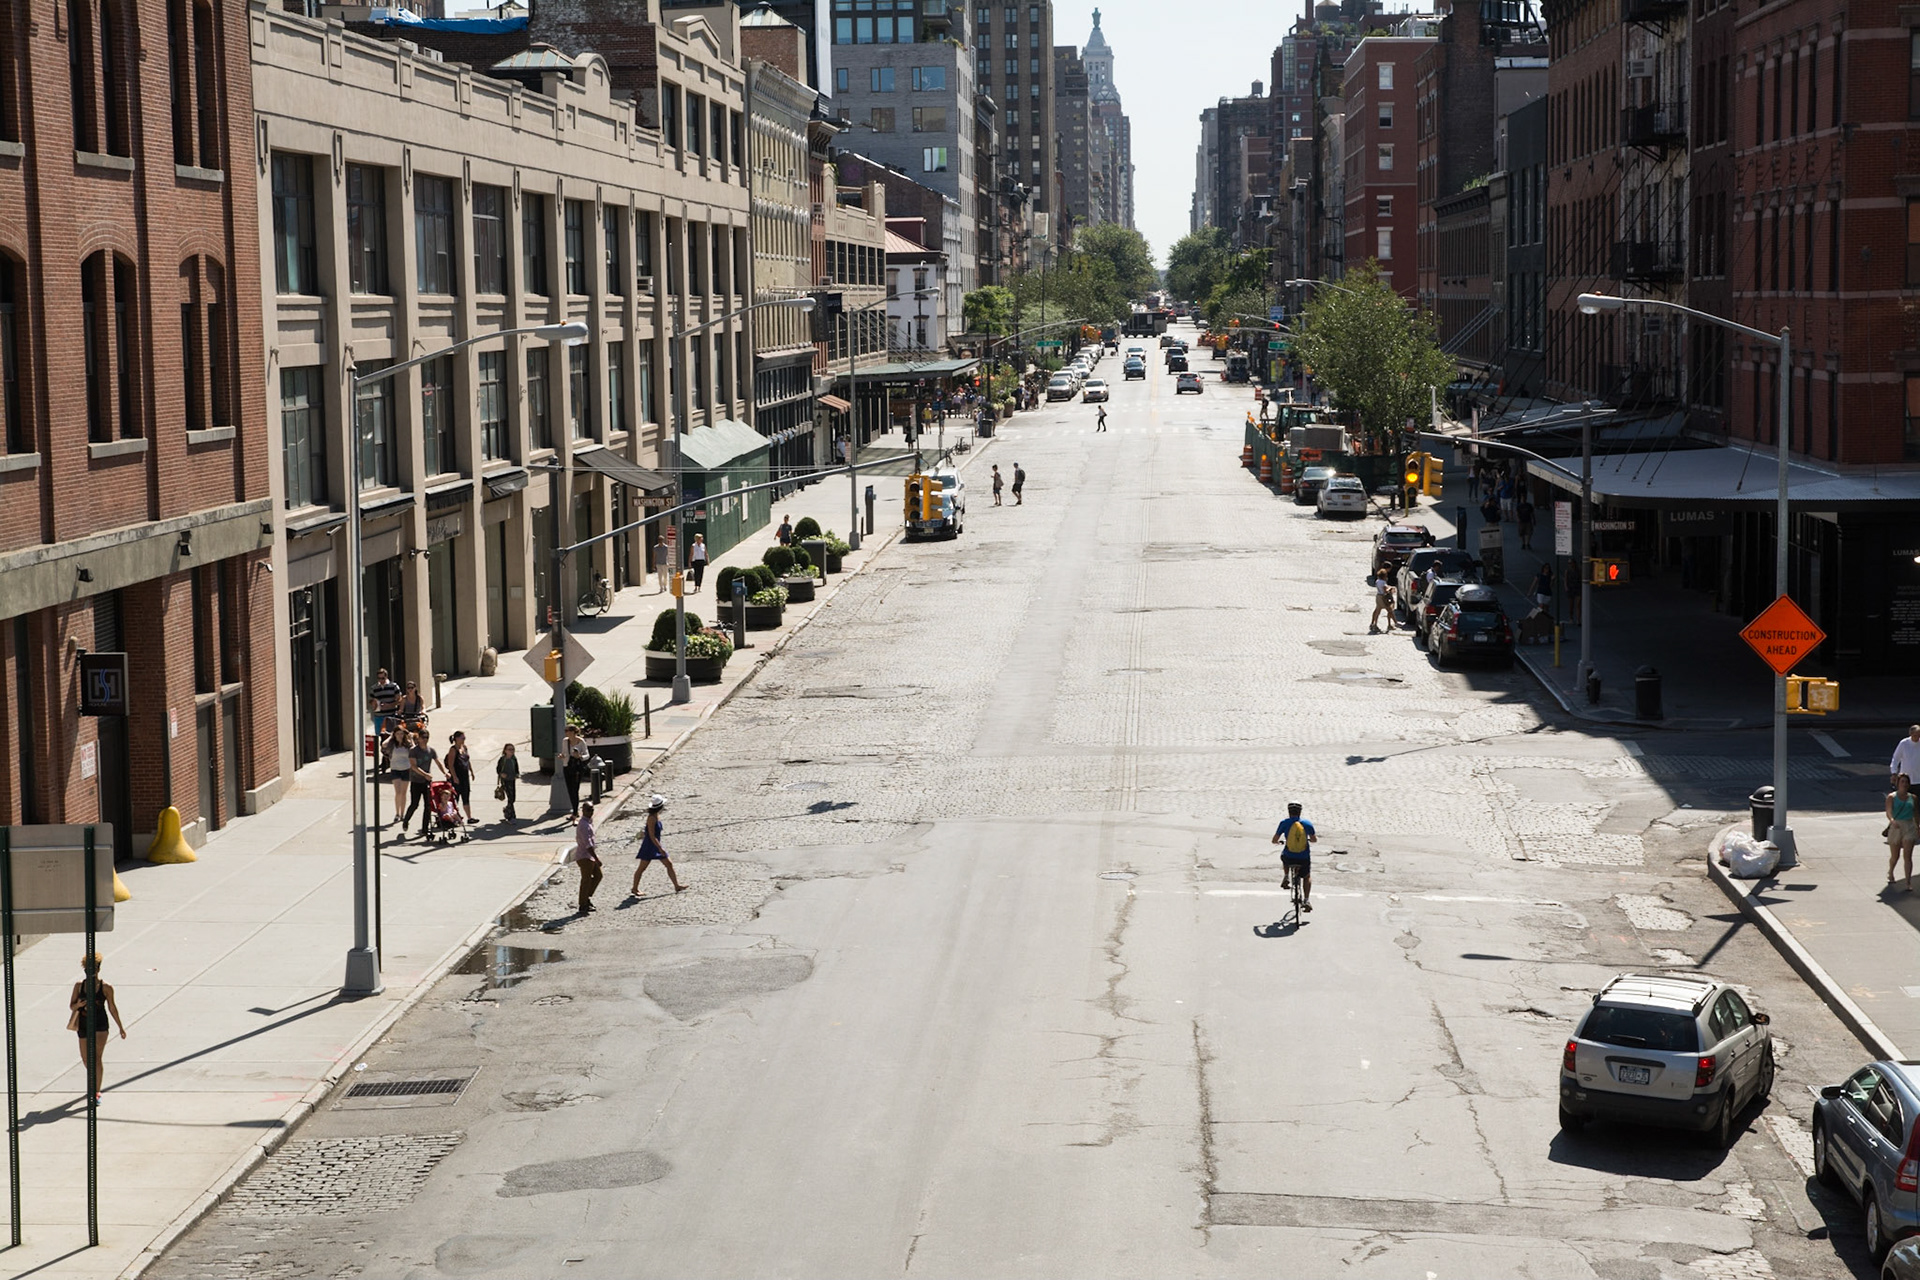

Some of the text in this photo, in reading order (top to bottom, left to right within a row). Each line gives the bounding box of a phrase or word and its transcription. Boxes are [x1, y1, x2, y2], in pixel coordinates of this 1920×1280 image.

[633, 498, 665, 507] WASHINGTON
[666, 497, 672, 506] ST
[1670, 511, 1715, 522] LUMAS
[1594, 521, 1635, 530] WASHINGTON ST
[1748, 630, 1817, 640] CONSTRUCTION
[1766, 646, 1797, 655] AHEAD
